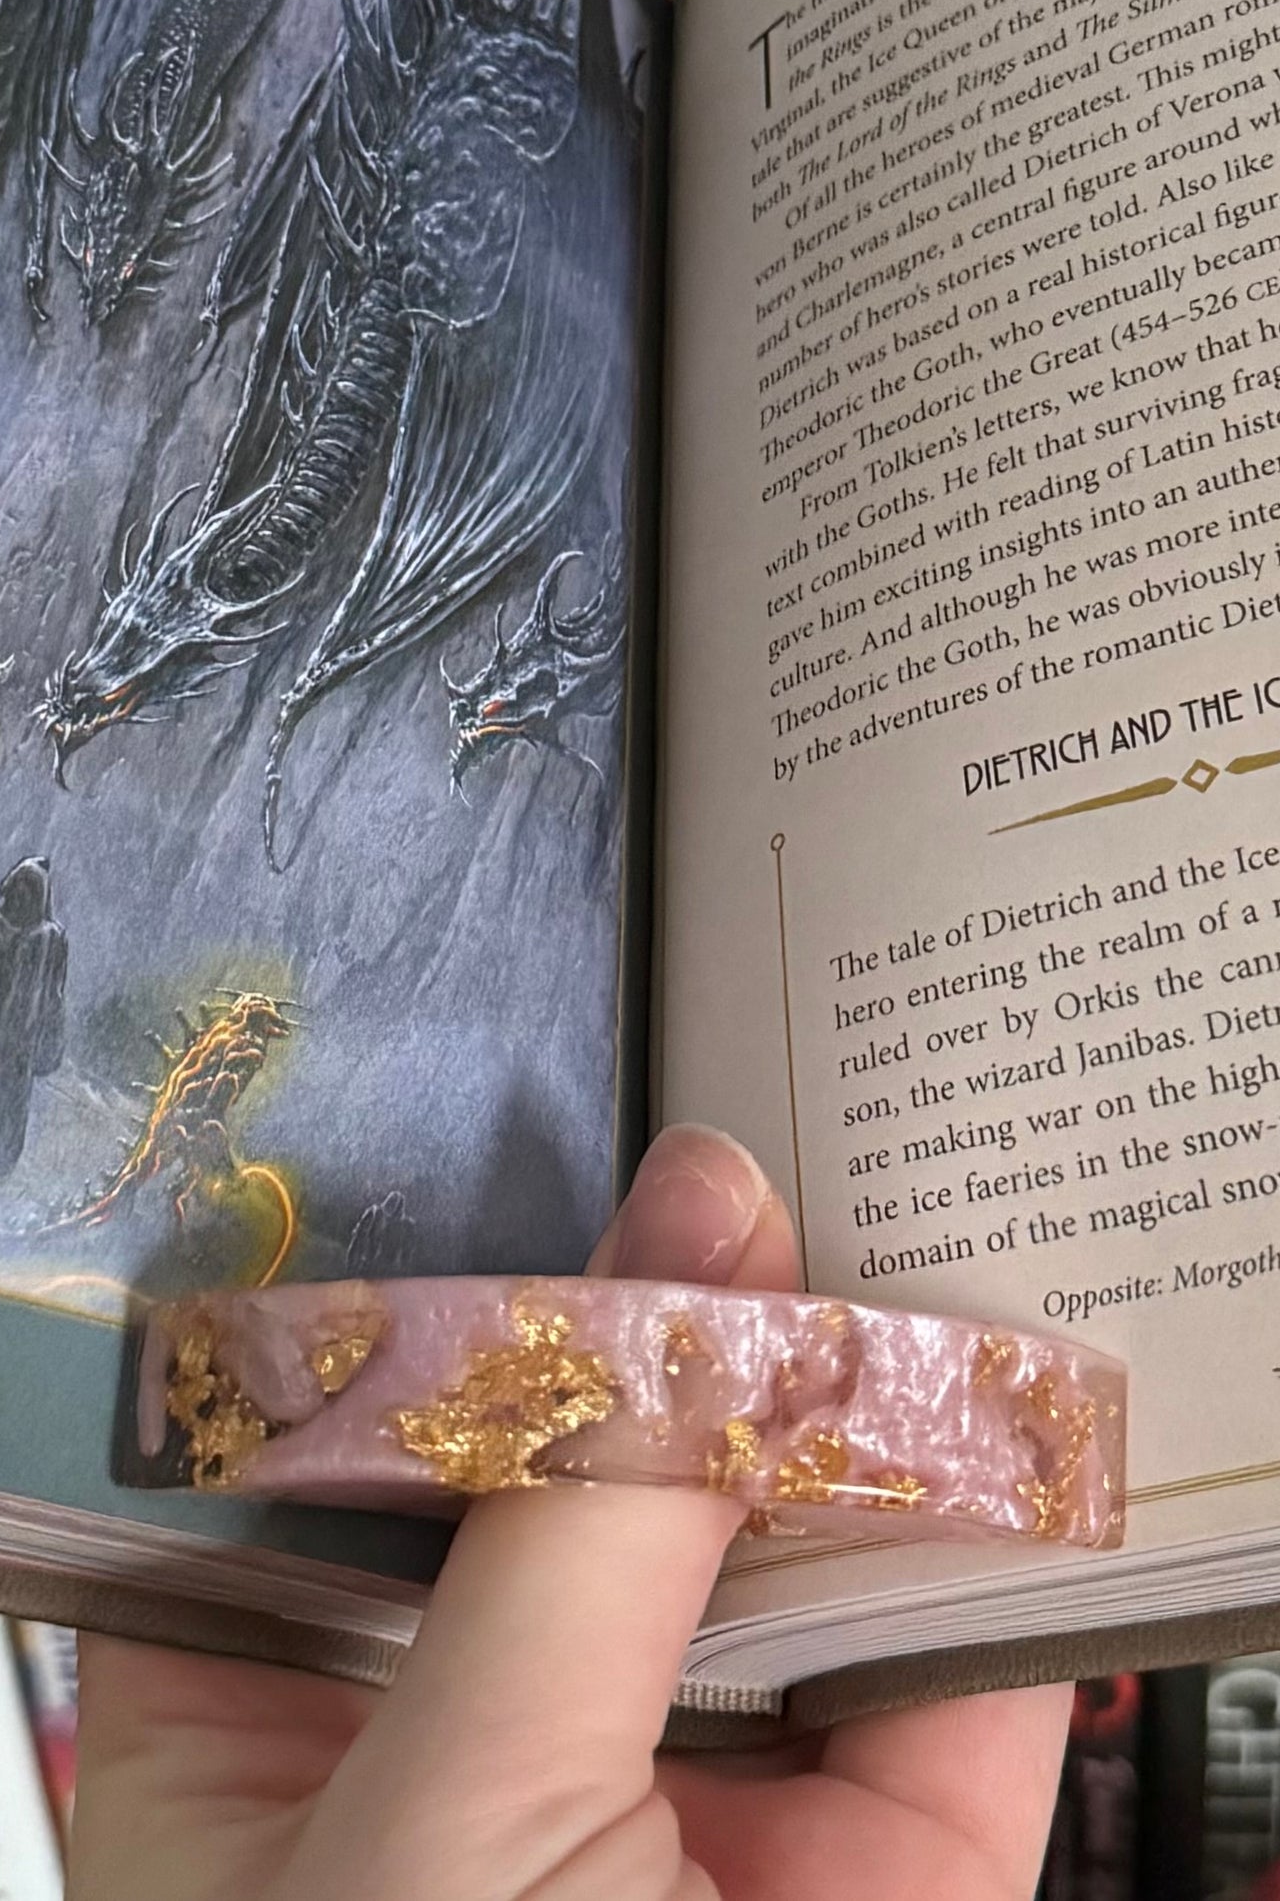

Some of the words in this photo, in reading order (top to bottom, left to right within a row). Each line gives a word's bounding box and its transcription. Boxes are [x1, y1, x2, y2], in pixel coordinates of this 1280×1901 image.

[747, 0, 806, 110] The
[753, 182, 791, 222] both
[799, 155, 830, 185] The
[838, 117, 882, 162] Lord
[890, 101, 911, 134] of
[916, 89, 948, 117] the
[957, 58, 1016, 97] Rings
[1024, 28, 1067, 66] and
[1076, 12, 1119, 40] The
[757, 319, 790, 358] and
[796, 245, 944, 329] Charlemagne,
[952, 233, 963, 249] a
[971, 187, 1054, 239] central
[1064, 162, 1137, 202] figure
[1145, 117, 1240, 170] around
[762, 443, 847, 503] emperor
[853, 386, 975, 450] Theodoric
[983, 369, 1022, 395] the
[1030, 336, 1103, 375] Great
[801, 478, 857, 519] From
[974, 399, 1060, 441] letters,
[1067, 381, 1104, 405] we
[1111, 352, 1187, 391] know
[1196, 329, 1251, 362] that
[767, 583, 803, 618] text
[811, 523, 926, 593] combined
[934, 502, 989, 540] with
[999, 468, 1100, 516] reading
[1107, 447, 1135, 479] of
[1140, 431, 1215, 468] Latin
[774, 754, 799, 782] by
[806, 737, 842, 765] the
[850, 683, 988, 746] adventures
[997, 662, 1023, 694] of
[1030, 656, 1074, 684] the
[1083, 615, 1214, 668] romantic
[963, 728, 1099, 797] DIETRICH
[1111, 709, 1171, 754] AND
[1179, 689, 1243, 732] THE
[829, 951, 878, 982] The
[888, 930, 935, 964] tale
[945, 914, 974, 947] of
[981, 884, 1102, 938] Dietrich
[1112, 865, 1168, 904] and
[1178, 857, 1226, 888] the
[1234, 847, 1280, 874] Ice
[835, 997, 894, 1031] hero
[908, 961, 1027, 1007] entering
[1038, 943, 1085, 973] the
[1099, 920, 1185, 959] realm
[1199, 900, 1229, 934] of
[1242, 905, 1259, 925] a
[840, 1032, 911, 1078] ruled
[927, 1021, 988, 1052] over
[1002, 1006, 1038, 1039] by
[1055, 982, 1139, 1020] Orkis
[1155, 967, 1203, 998] the
[844, 1098, 899, 1127] son,
[910, 1077, 954, 1108] the
[965, 1045, 1066, 1094] wizard
[1076, 1027, 1194, 1076] Janibas.
[848, 1150, 890, 1177] are
[903, 1120, 1016, 1163] making
[1026, 1105, 1082, 1134] war
[1096, 1095, 1135, 1119] on
[1148, 1076, 1196, 1108] the
[853, 1196, 898, 1228] the
[911, 1188, 952, 1214] ice
[965, 1164, 1064, 1202] faeries
[1077, 1155, 1108, 1179] in
[1120, 1137, 1170, 1169] the
[860, 1238, 974, 1279] domain
[987, 1217, 1017, 1252] of
[1028, 1212, 1076, 1244] the
[1089, 1179, 1211, 1232] magical
[1043, 1276, 1162, 1322] Opposite:
